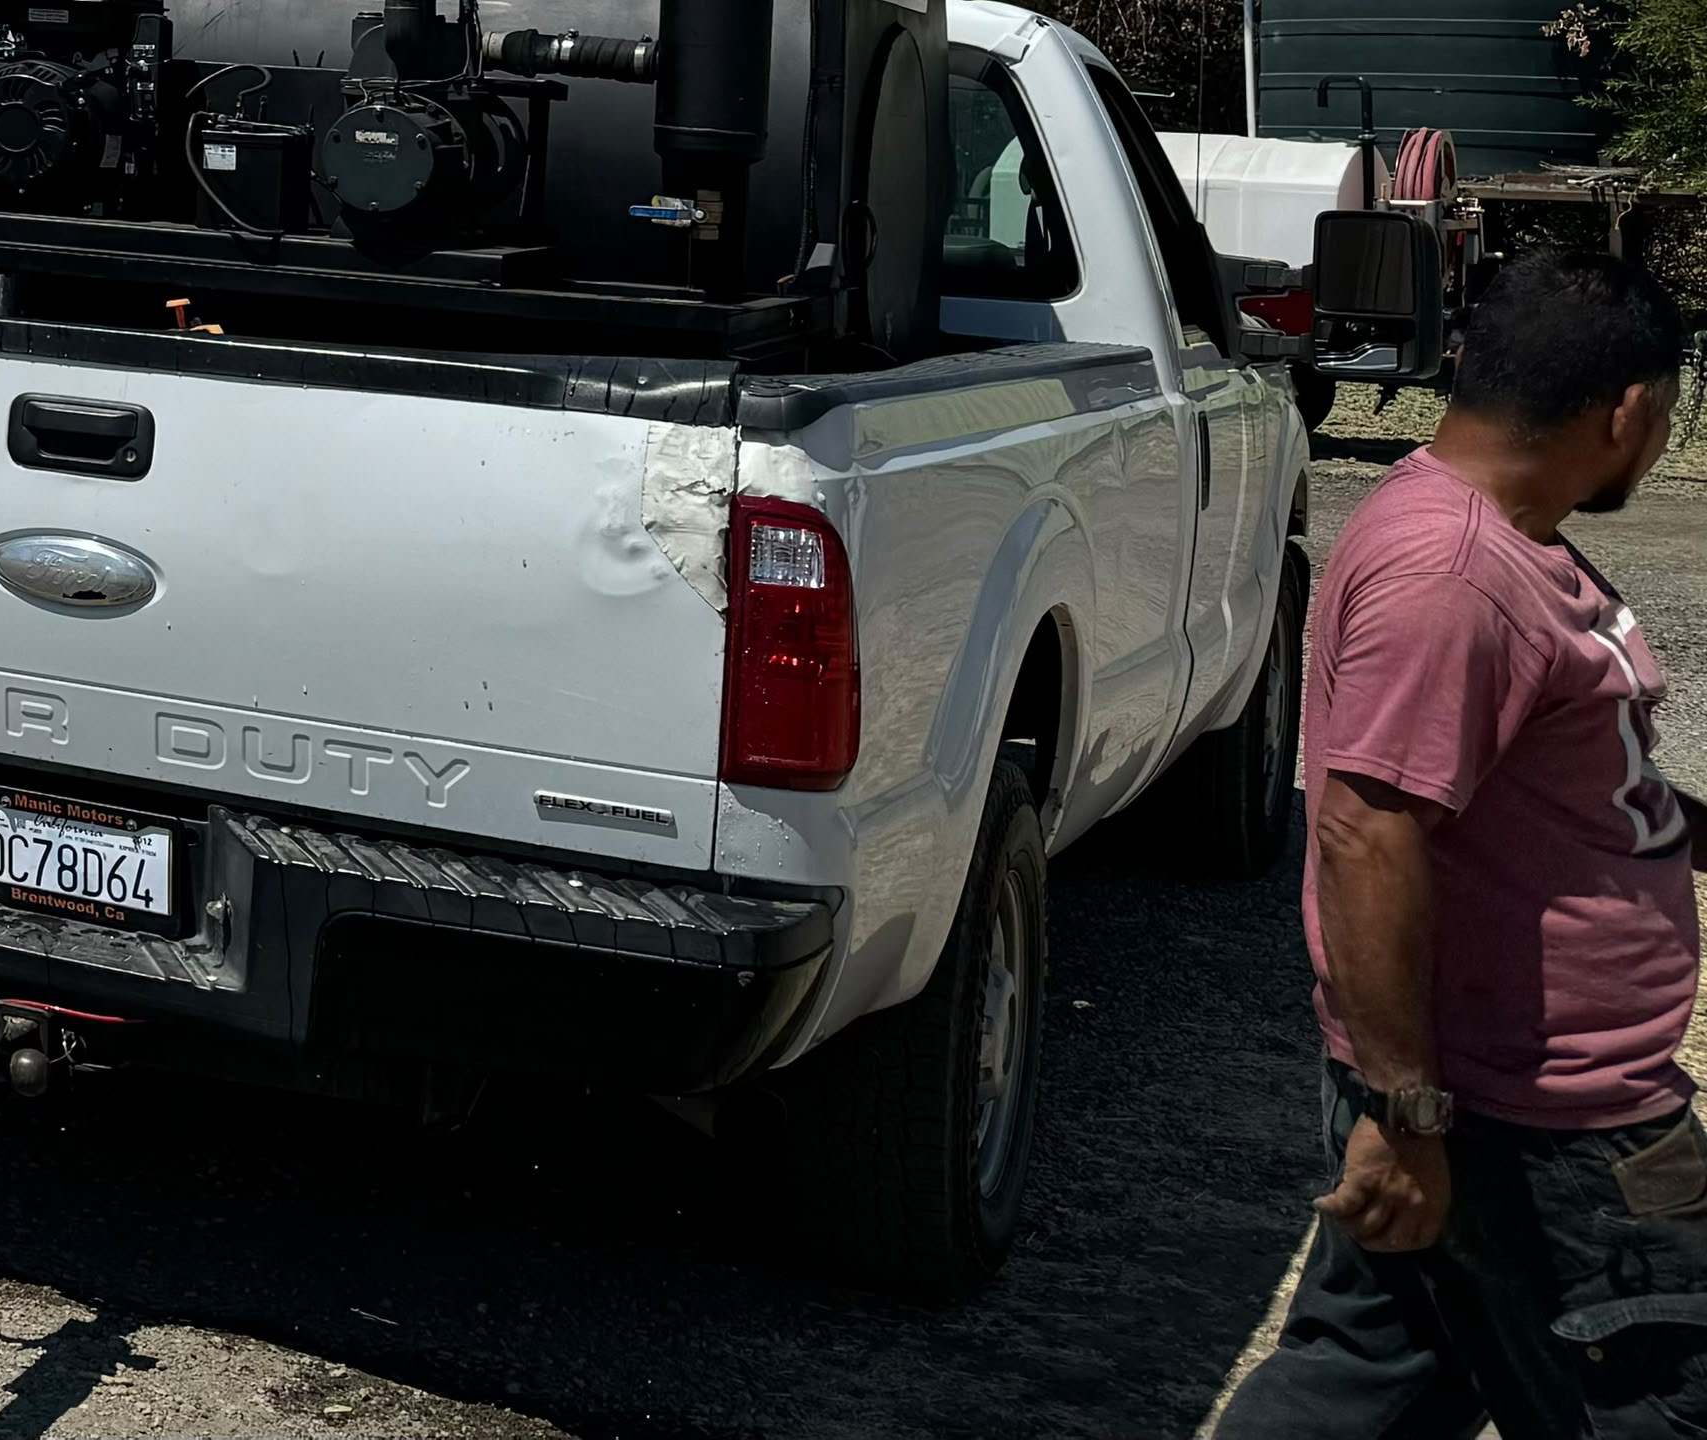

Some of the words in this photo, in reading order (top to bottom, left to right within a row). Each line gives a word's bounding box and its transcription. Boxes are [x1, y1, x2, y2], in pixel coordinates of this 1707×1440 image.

[154, 711, 472, 810] DUTY
[14, 794, 62, 815] Manic
[68, 803, 124, 826] Motors
[538, 794, 592, 812] FLEX
[612, 805, 670, 824] FUEL
[11, 887, 100, 918] Brentwood,
[104, 905, 125, 921] Ca
